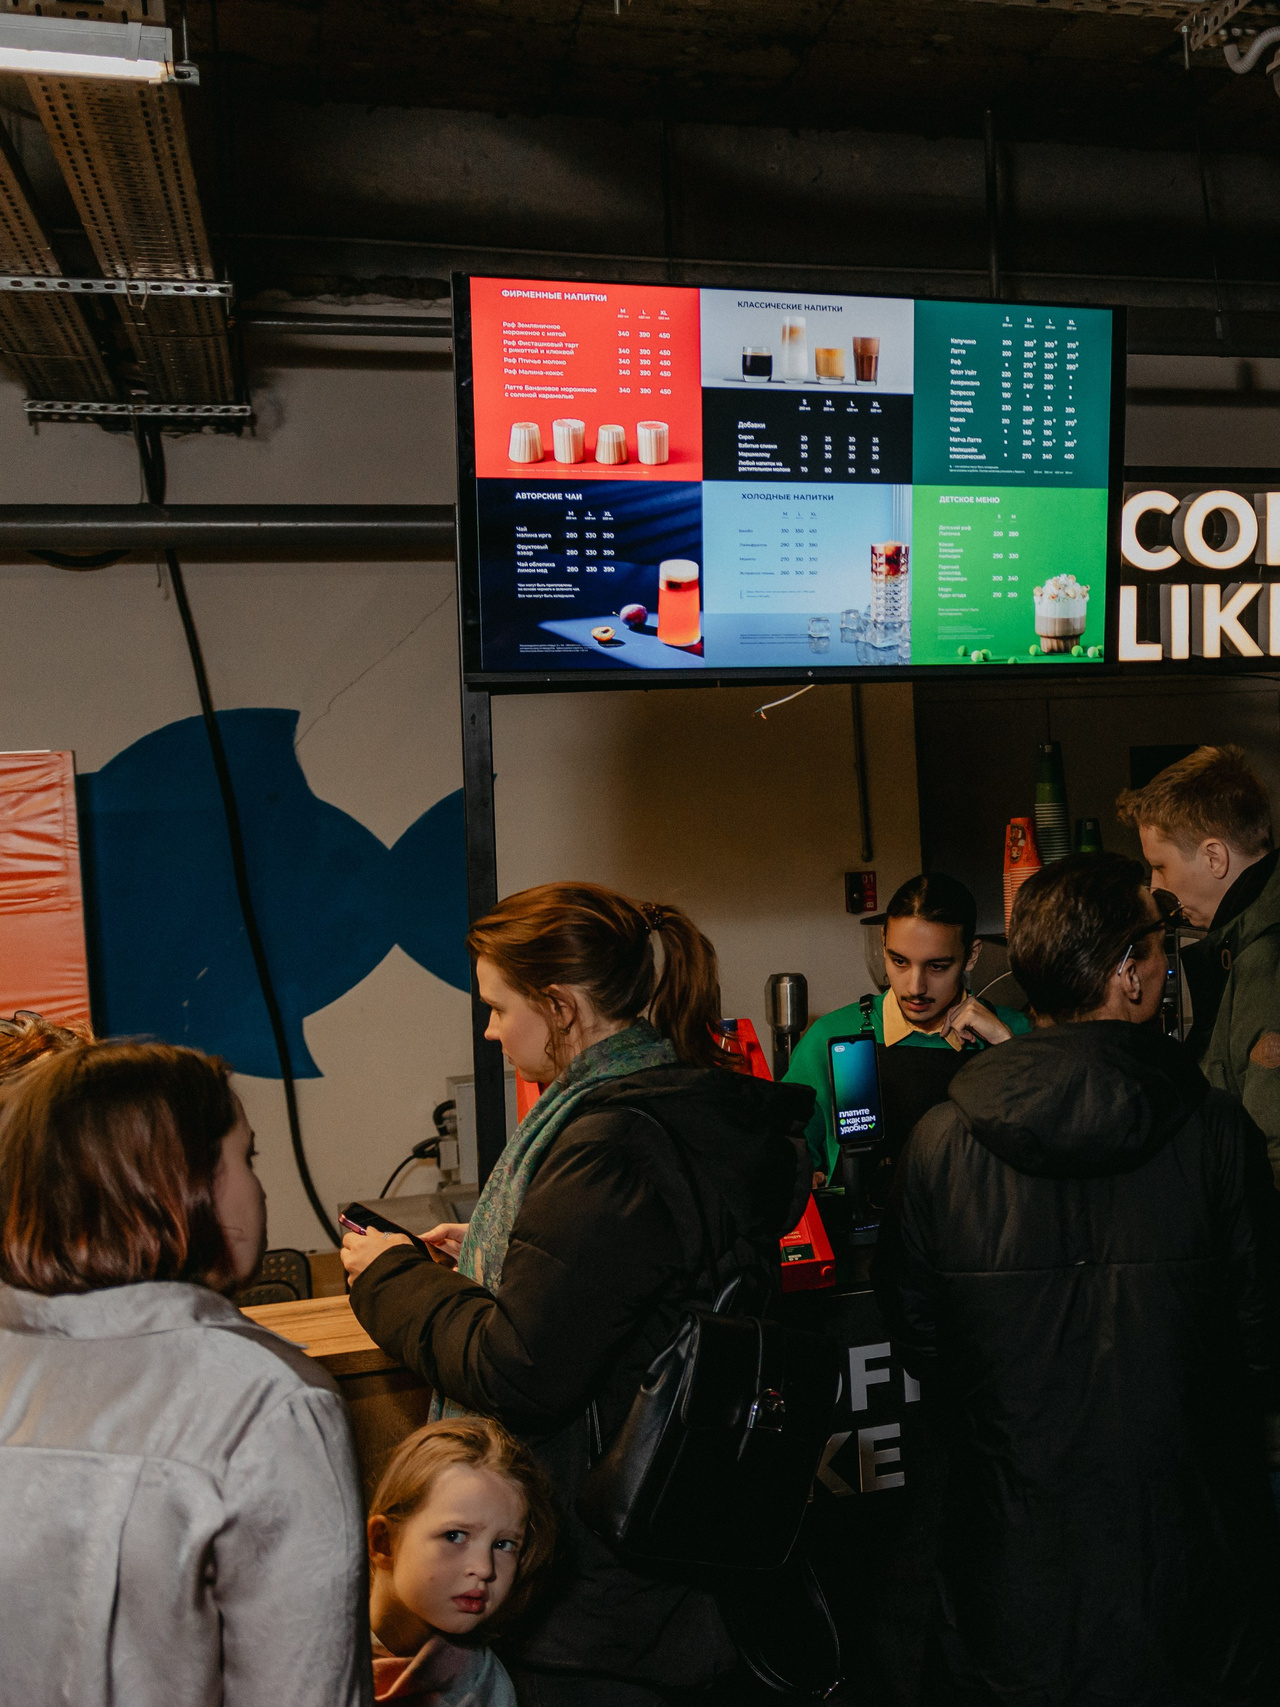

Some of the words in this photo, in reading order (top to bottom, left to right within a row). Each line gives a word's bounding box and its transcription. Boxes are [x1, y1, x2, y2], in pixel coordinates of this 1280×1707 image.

[502, 289, 562, 300] ФИРМЕННЫЕ
[564, 293, 607, 301] НАПИТКИ
[738, 301, 802, 310] КЛАССИЧЕСКИЕ
[805, 304, 843, 312] НАПИТКИ
[503, 329, 540, 337] мороженое
[839, 1108, 870, 1118] платите
[847, 1117, 860, 1125] как
[861, 1115, 876, 1123] вам
[840, 1123, 868, 1135] удобно
[807, 1423, 905, 1503] KE
